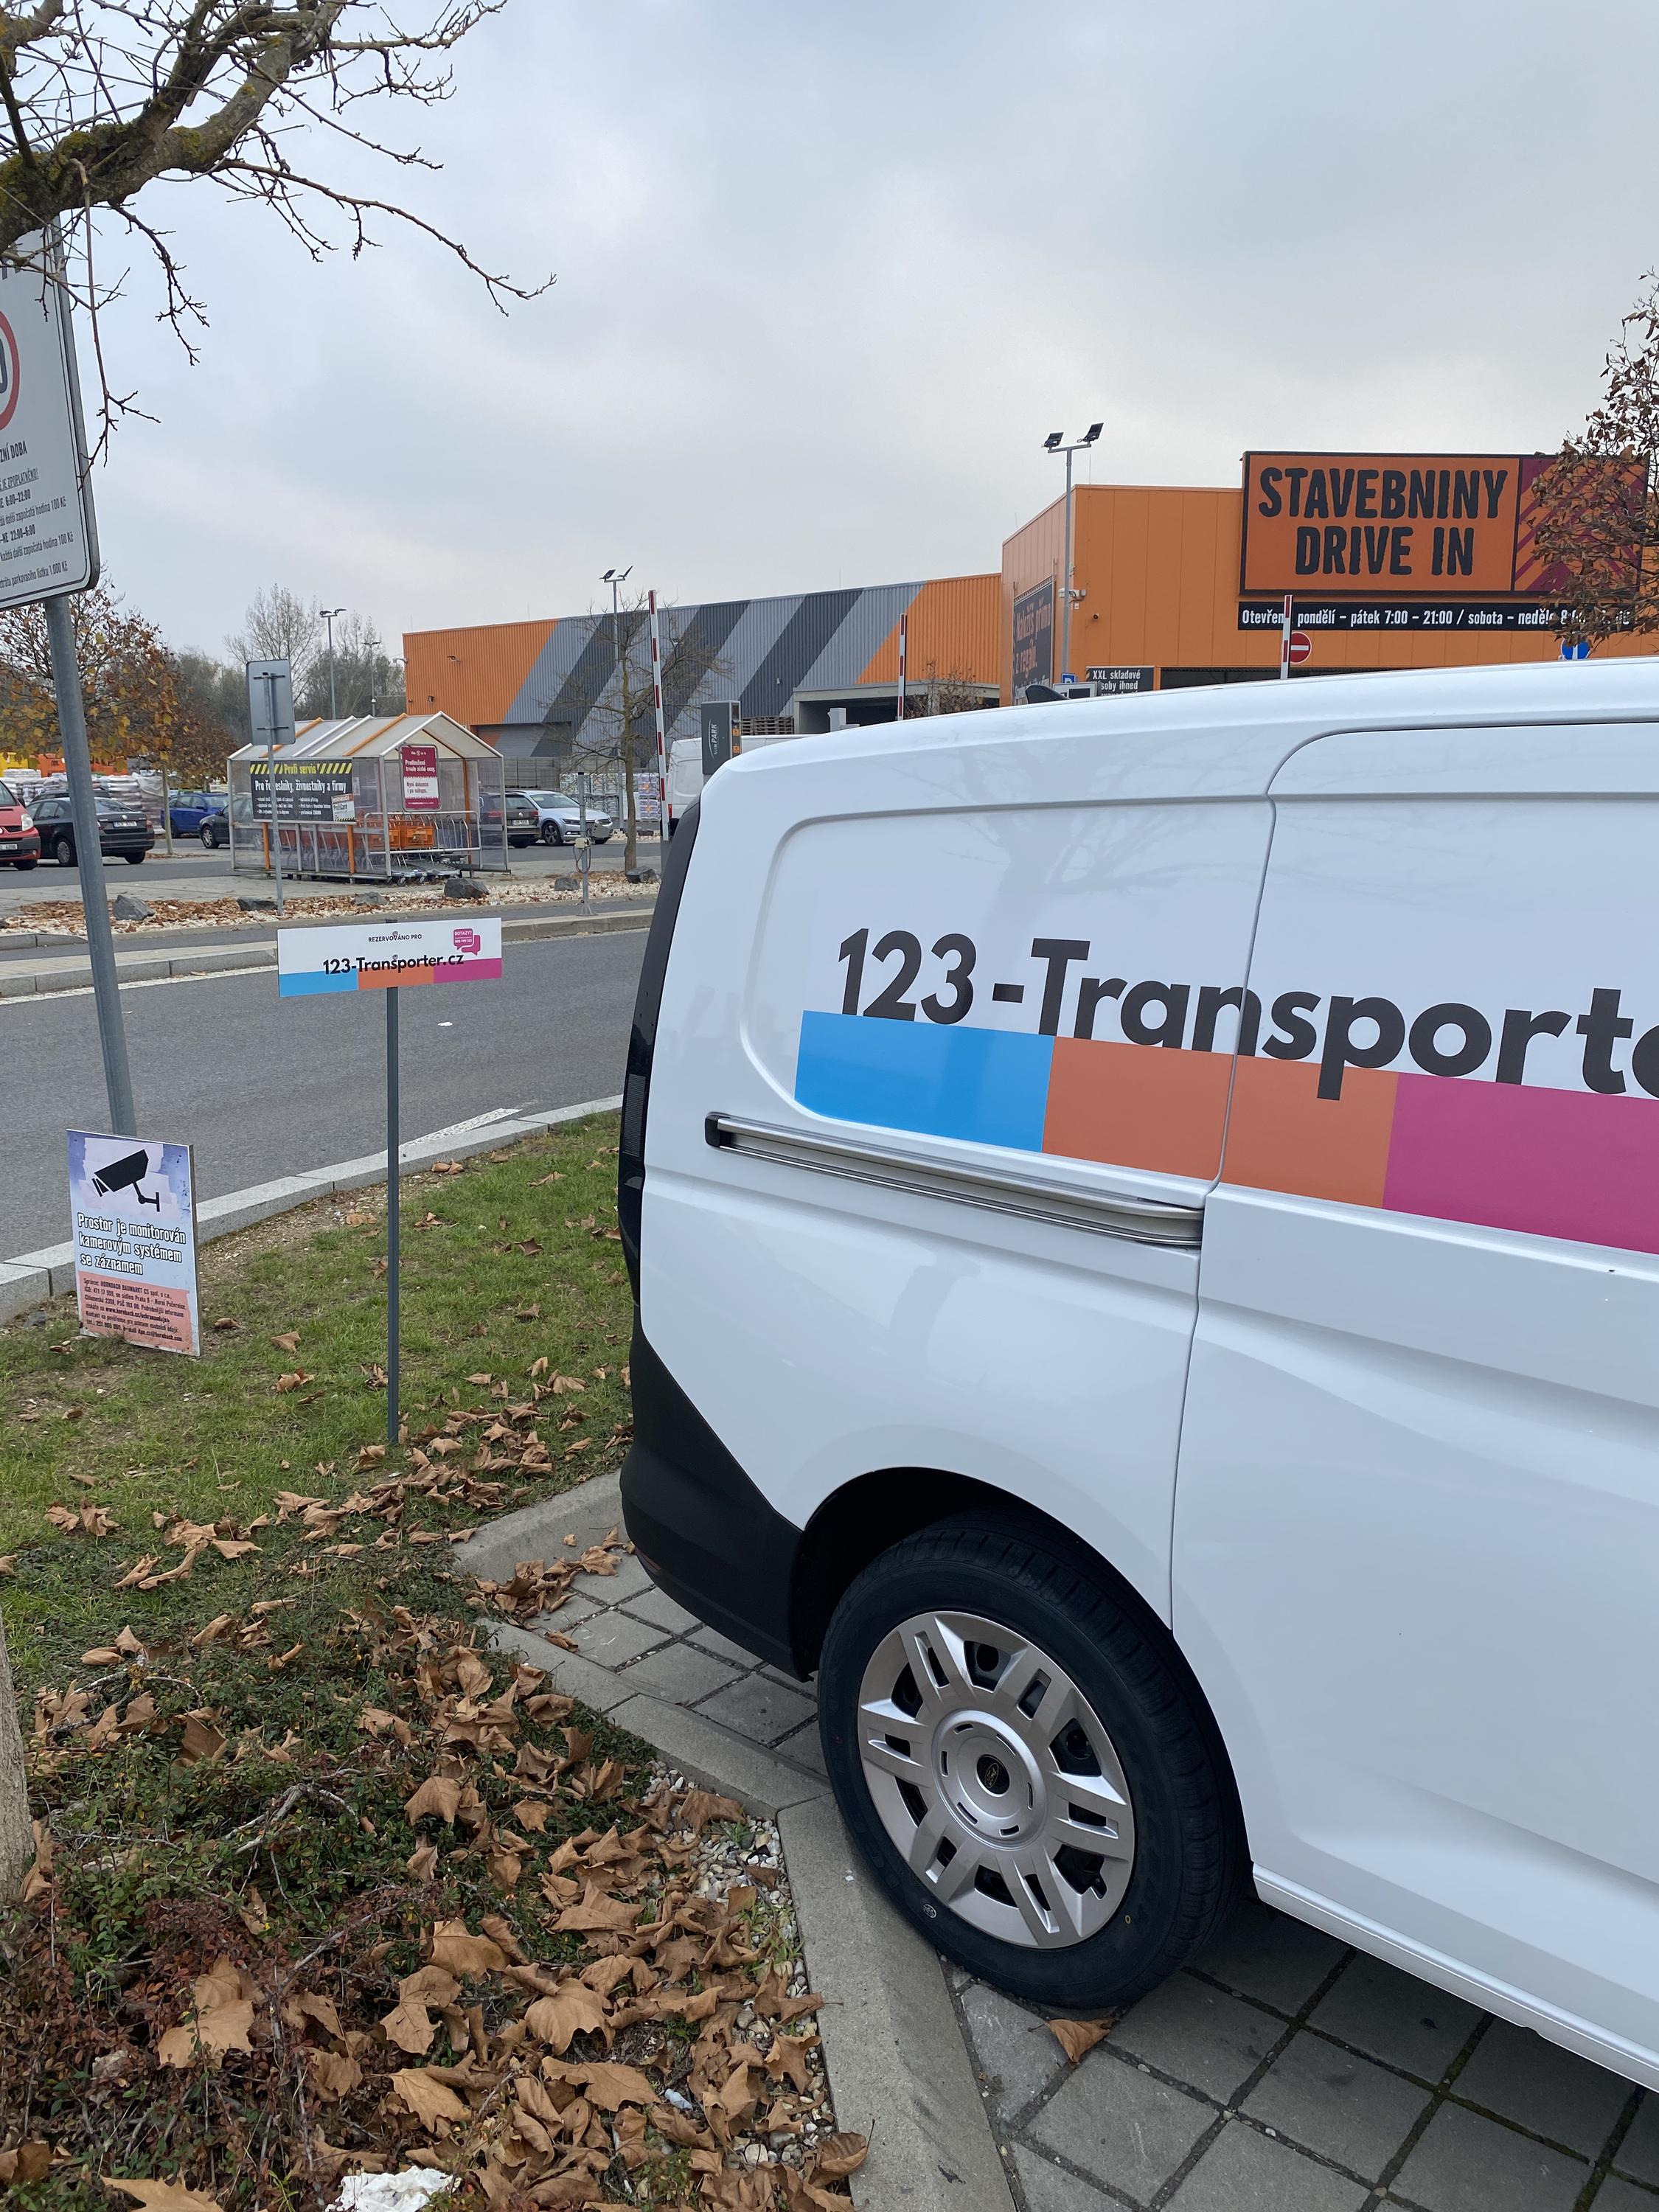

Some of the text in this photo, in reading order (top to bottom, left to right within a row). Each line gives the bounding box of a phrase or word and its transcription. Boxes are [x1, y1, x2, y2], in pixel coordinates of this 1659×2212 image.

[10, 440, 28, 459] DOBA
[51, 498, 60, 510] 100
[60, 495, 66, 507] Kč
[1258, 467, 1508, 519] STAVEBNINY
[58, 533, 67, 546] 100
[67, 531, 74, 543] Kč
[1295, 526, 1475, 576] DRIVE IN
[61, 560, 68, 573] Kč
[1242, 608, 1286, 625] Otevřen
[1297, 608, 1336, 627] pondělí
[1350, 608, 1380, 627] pátek
[1385, 610, 1408, 625] 7:00
[1422, 610, 1453, 625] 21:00
[1467, 611, 1503, 625] sobota
[1093, 669, 1141, 680] XXL skladové
[1119, 681, 1138, 690] ihned
[283, 762, 317, 774] Profi servis
[254, 779, 347, 793] Pro řeeslníky, živnostníky a firmy
[323, 953, 465, 975] 123-Transporter.cz
[77, 1213, 186, 1245] Prostor je monitorován
[79, 1232, 182, 1263] kamerovým systémem
[80, 1254, 143, 1276] se záznamem
